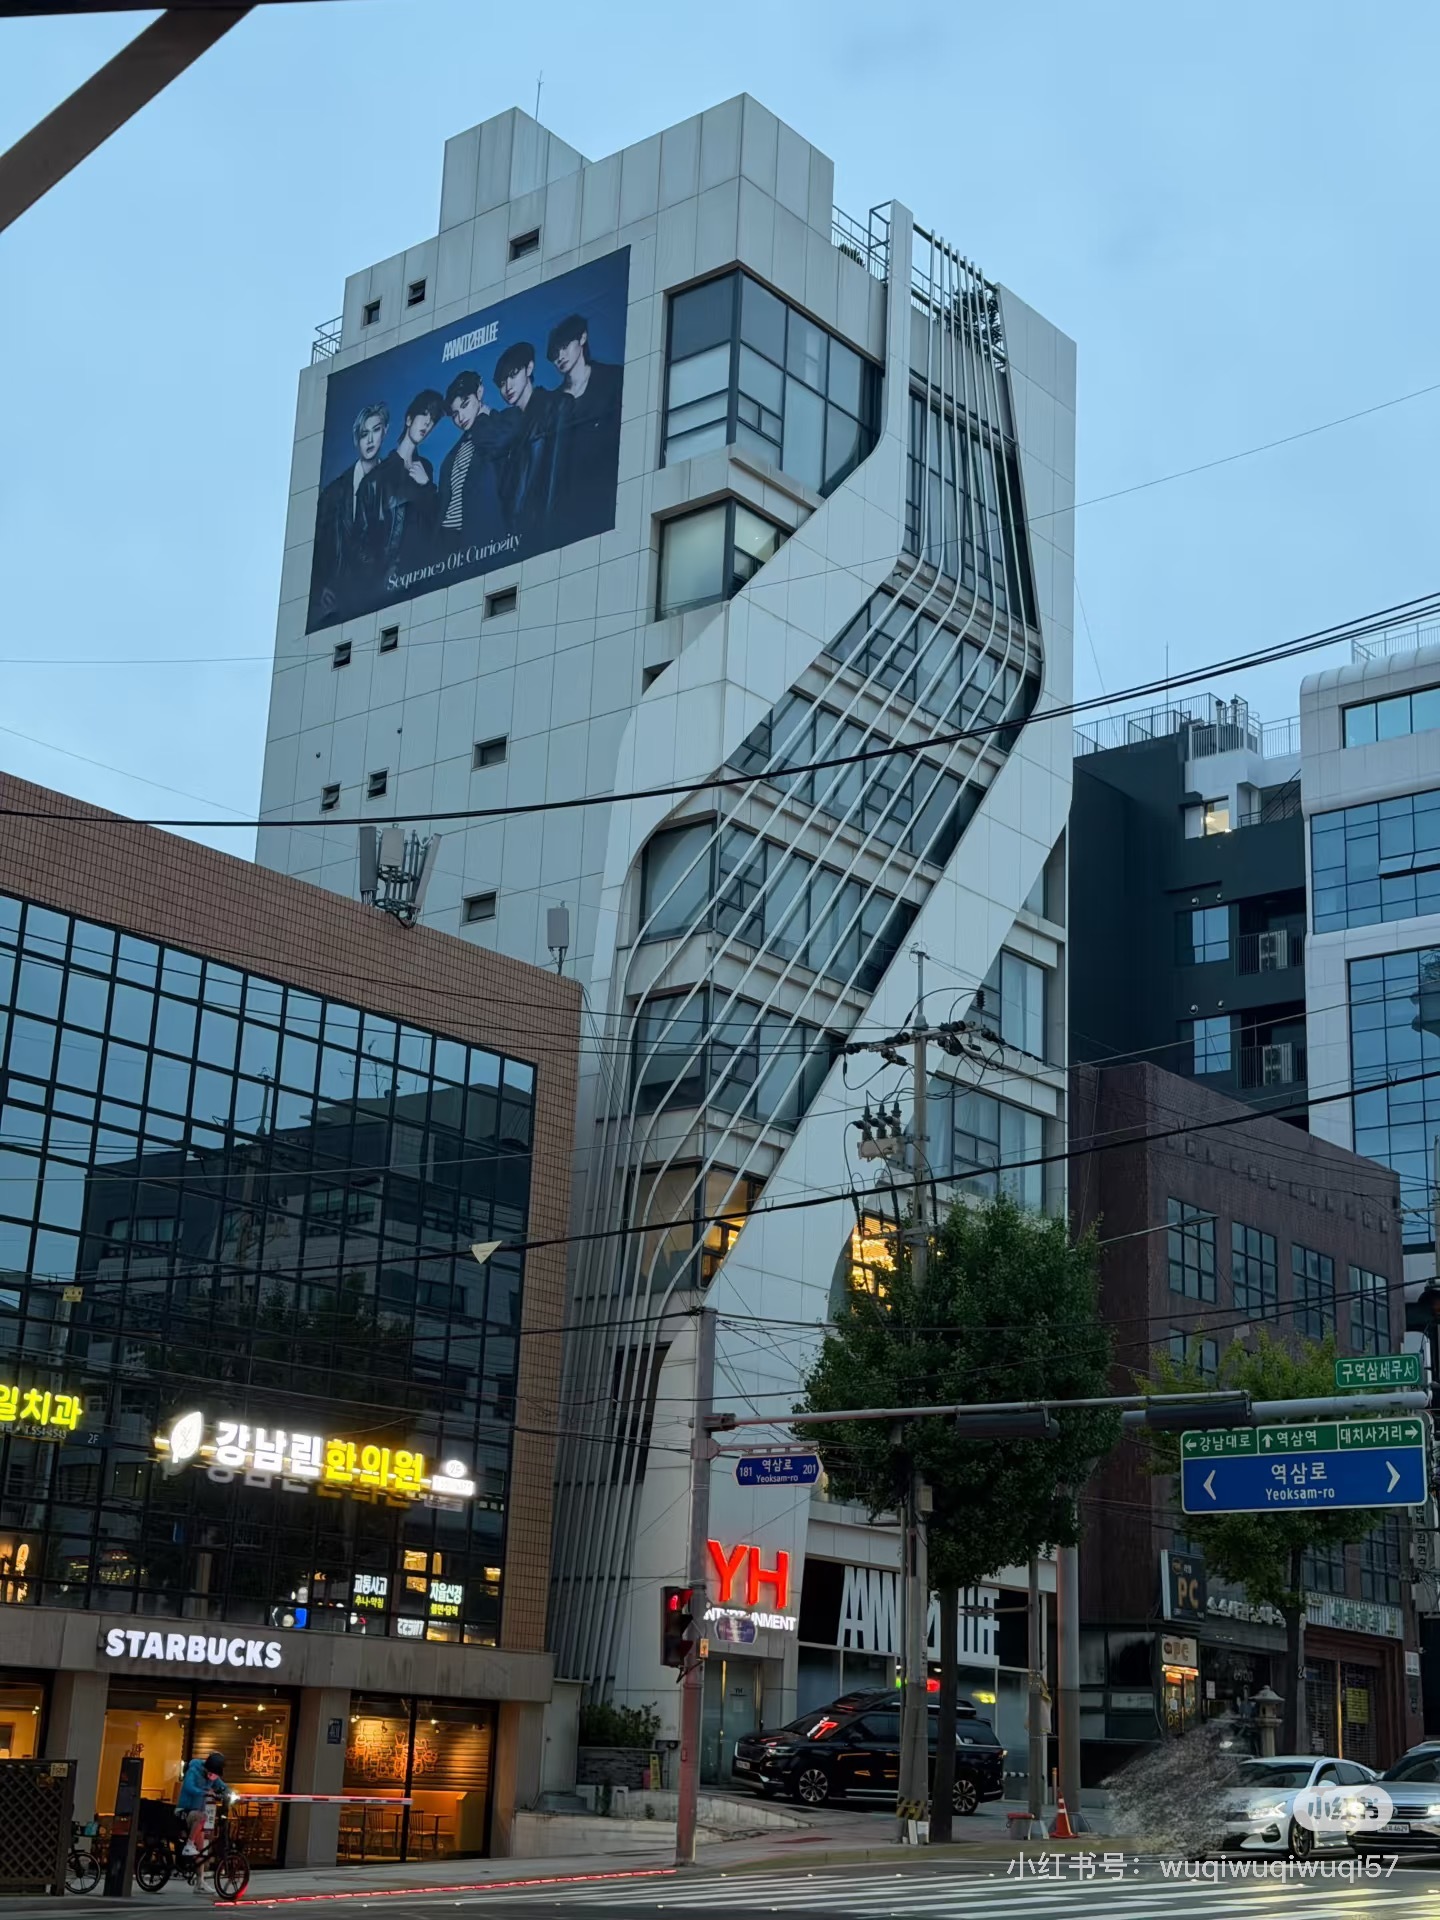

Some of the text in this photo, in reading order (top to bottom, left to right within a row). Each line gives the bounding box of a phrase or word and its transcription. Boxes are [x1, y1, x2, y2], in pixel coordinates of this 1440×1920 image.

[87, 1433, 100, 1444] 2F
[1200, 1433, 1251, 1452] 강남대로
[1276, 1430, 1317, 1447] 역삼역
[1340, 1425, 1402, 1444] 대치사거리
[740, 1466, 753, 1477] 181
[762, 1459, 793, 1473] 역삼로
[802, 1464, 816, 1475] 201
[1271, 1462, 1327, 1485] 역삼로
[756, 1474, 799, 1483] Yeoksam-ro
[1266, 1487, 1335, 1501] Yeoksam-ro
[707, 1539, 789, 1609] YH
[354, 1574, 387, 1595] 교통사고
[1178, 1577, 1199, 1609] PC
[106, 1628, 282, 1669] STARBUCKS
